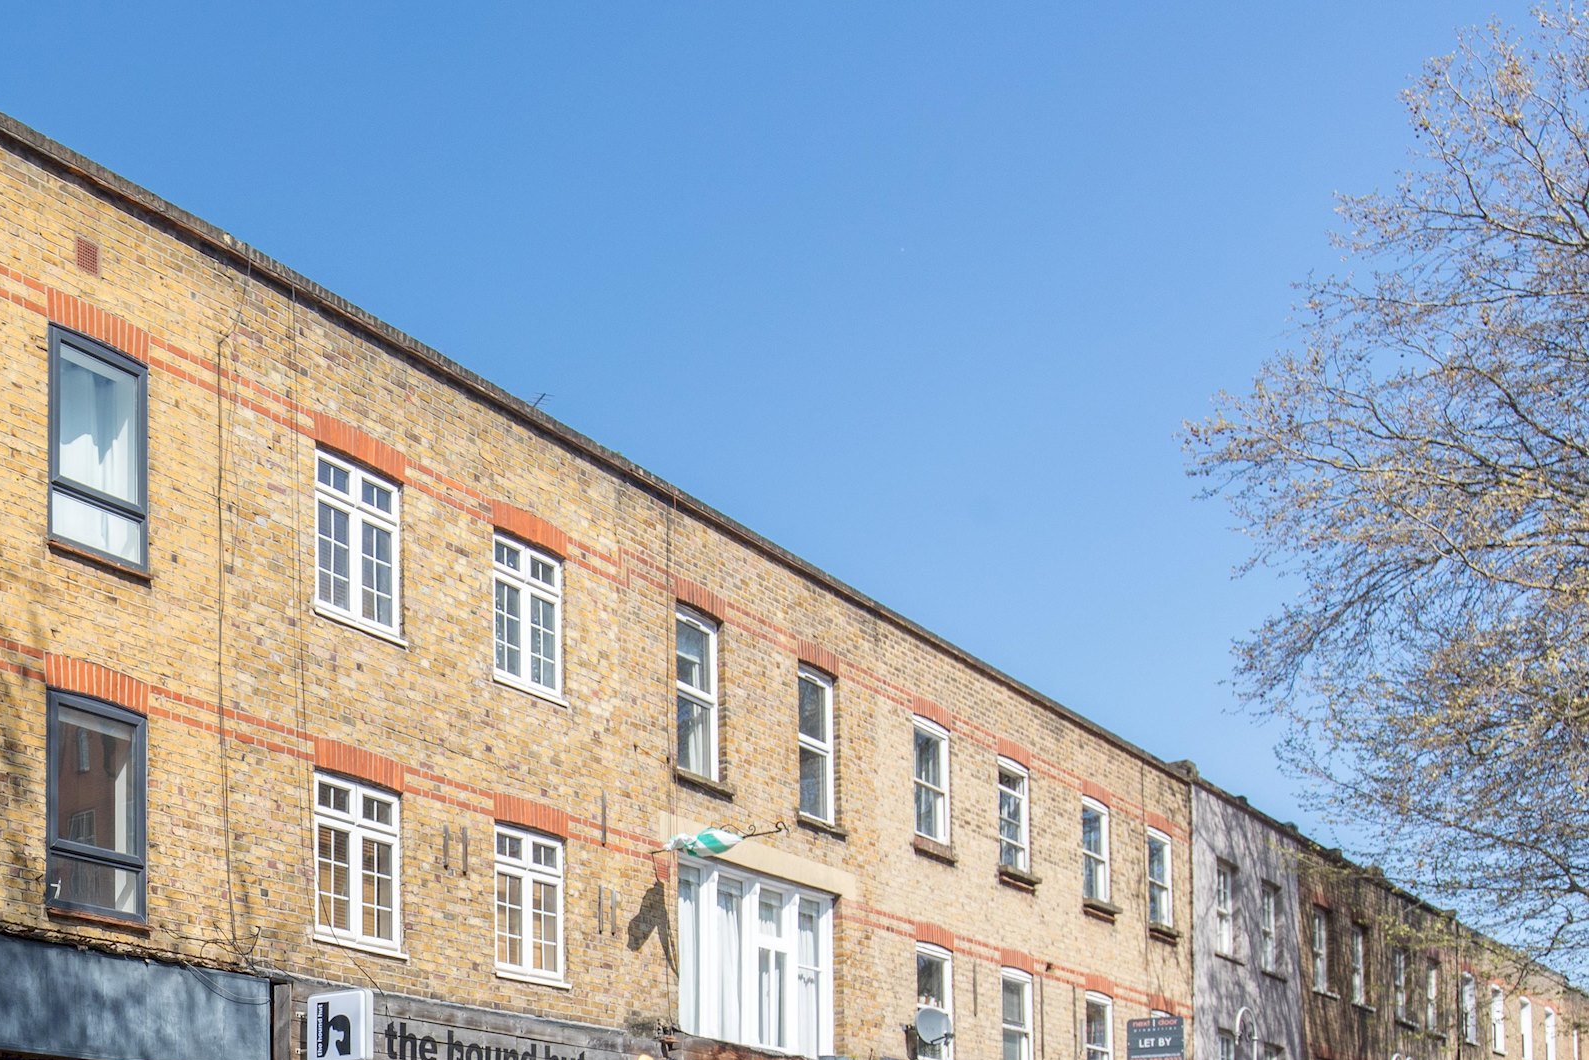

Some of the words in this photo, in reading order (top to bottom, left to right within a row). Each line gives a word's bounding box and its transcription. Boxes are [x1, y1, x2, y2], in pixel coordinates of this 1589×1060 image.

[1158, 1018, 1178, 1026] door
[1139, 1038, 1155, 1048] LET
[1158, 1037, 1172, 1047] BY
